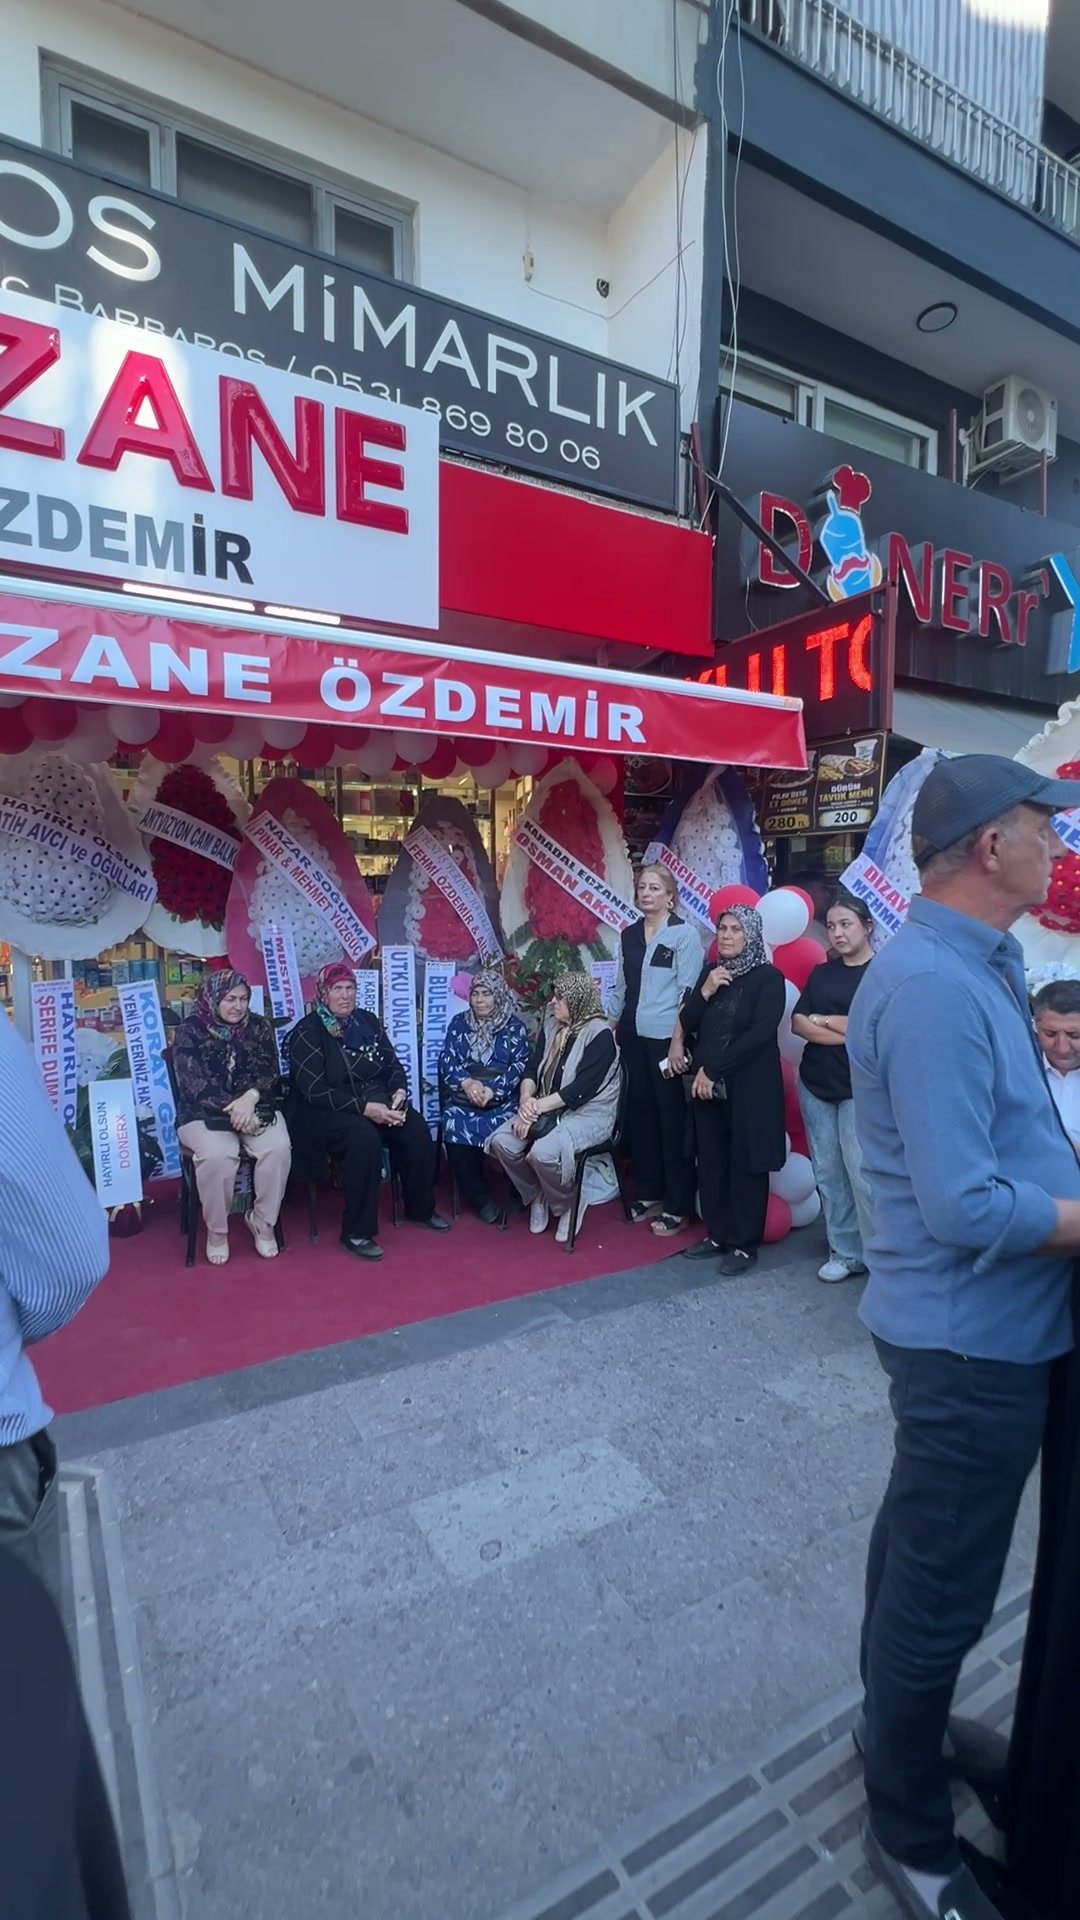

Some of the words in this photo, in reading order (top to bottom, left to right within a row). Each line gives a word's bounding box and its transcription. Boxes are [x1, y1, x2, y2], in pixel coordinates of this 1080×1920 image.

[421, 397, 492, 438] 869
[505, 423, 549, 454] 80
[559, 440, 601, 470] 06
[0, 622, 272, 703] ZANE
[318, 656, 647, 744] ÖZDEMİR
[2, 797, 87, 837] HAYIRLI
[92, 835, 148, 879] OLSUN
[769, 817, 796, 829] 280
[834, 811, 858, 824] 200
[0, 810, 28, 835] TİH
[26, 822, 69, 851] AVCI
[70, 843, 88, 860] ve
[90, 851, 154, 902] OĞULLARI
[190, 827, 214, 856] CAM
[213, 838, 236, 868] BALK
[256, 828, 284, 861] PINAR
[281, 856, 290, 869] &
[290, 865, 334, 913] MEHMET
[516, 832, 579, 891] OSMAN
[265, 818, 312, 870] NAZAR
[312, 870, 370, 947] SOĞUTMA
[263, 938, 281, 992] TARIM
[275, 937, 295, 1018] MUSTAFA
[390, 951, 409, 992] UTKU
[392, 999, 414, 1039] ÜNAL
[426, 975, 452, 1034] BÜLENT
[61, 992, 76, 1096] HAYIRLI
[139, 991, 169, 1091] KORAY
[157, 1102, 181, 1171] GSM
[97, 1101, 109, 1145] OLSUN
[115, 1113, 130, 1169] DONERX
[99, 1145, 113, 1188] HAYIRLI
